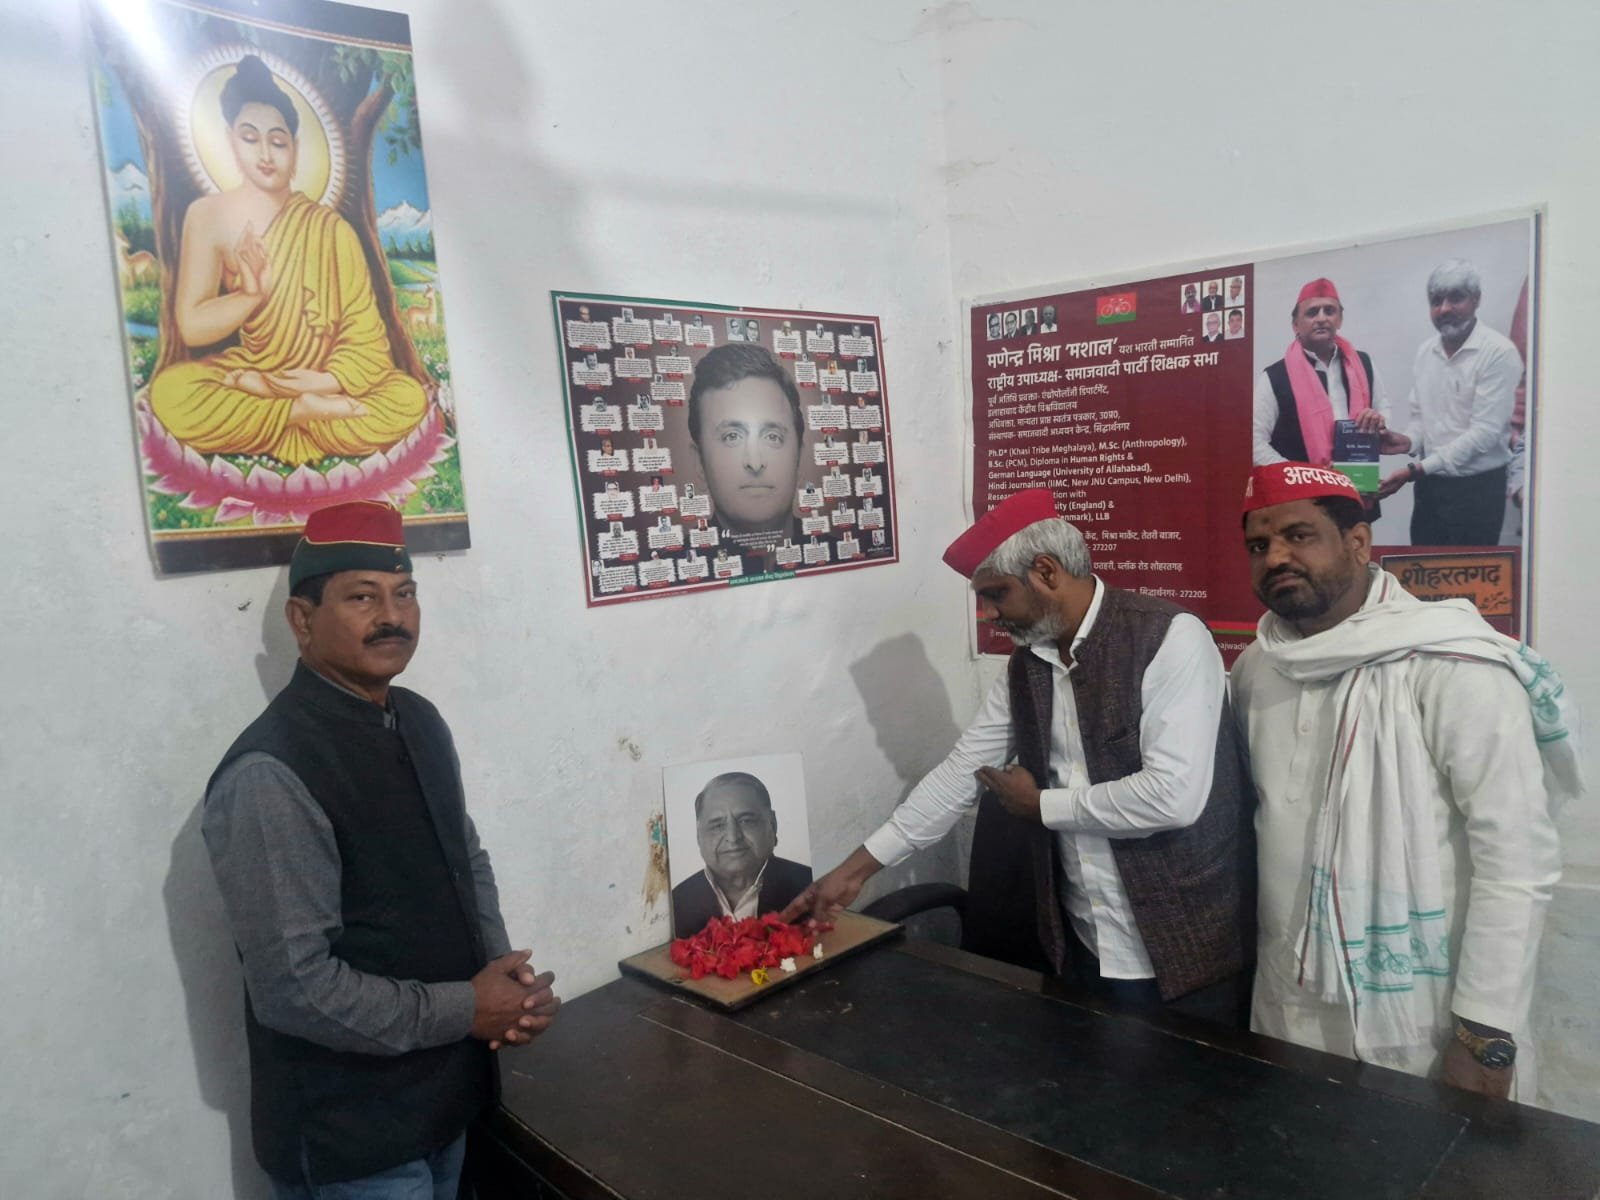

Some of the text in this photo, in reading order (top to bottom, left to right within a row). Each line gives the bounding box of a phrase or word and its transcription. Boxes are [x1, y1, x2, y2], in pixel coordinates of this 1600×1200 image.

[987, 346, 1024, 368] मणेन्द्र
[1027, 343, 1061, 364] मिश्रा
[1119, 344, 1133, 354] यश
[1135, 338, 1157, 353] भारती
[1160, 334, 1195, 350] सम्मानित
[987, 373, 1014, 392] राष्ट्रीय
[1065, 359, 1120, 381] समाजवादी
[1123, 355, 1149, 374] पार्टी
[1150, 354, 1191, 372] शिक्षक
[1193, 352, 1219, 367] सभा
[1009, 446, 1030, 457] (Khasi
[1032, 446, 1050, 454] Tribe
[1030, 457, 1060, 467] Diploma
[1061, 456, 1068, 464] in
[1070, 455, 1097, 463] Human
[1099, 452, 1125, 463] Rights
[1127, 452, 1134, 460] &
[988, 470, 1015, 479] German
[1016, 468, 1051, 479] Language
[1052, 466, 1094, 478] (University
[1095, 465, 1104, 474] of
[988, 481, 1007, 490] Hindi
[1008, 479, 1046, 489] Journalism
[1071, 478, 1089, 486] New
[1090, 477, 1105, 486] JNU
[1107, 476, 1142, 486] Campus,
[1143, 475, 1162, 484] New
[1069, 490, 1087, 498] with
[1068, 500, 1106, 512] (England)
[1107, 500, 1115, 509] &
[1096, 512, 1110, 521] LLB
[1092, 543, 1117, 551] 272207
[1138, 560, 1149, 570] रोड
[1180, 589, 1208, 599] 272205
